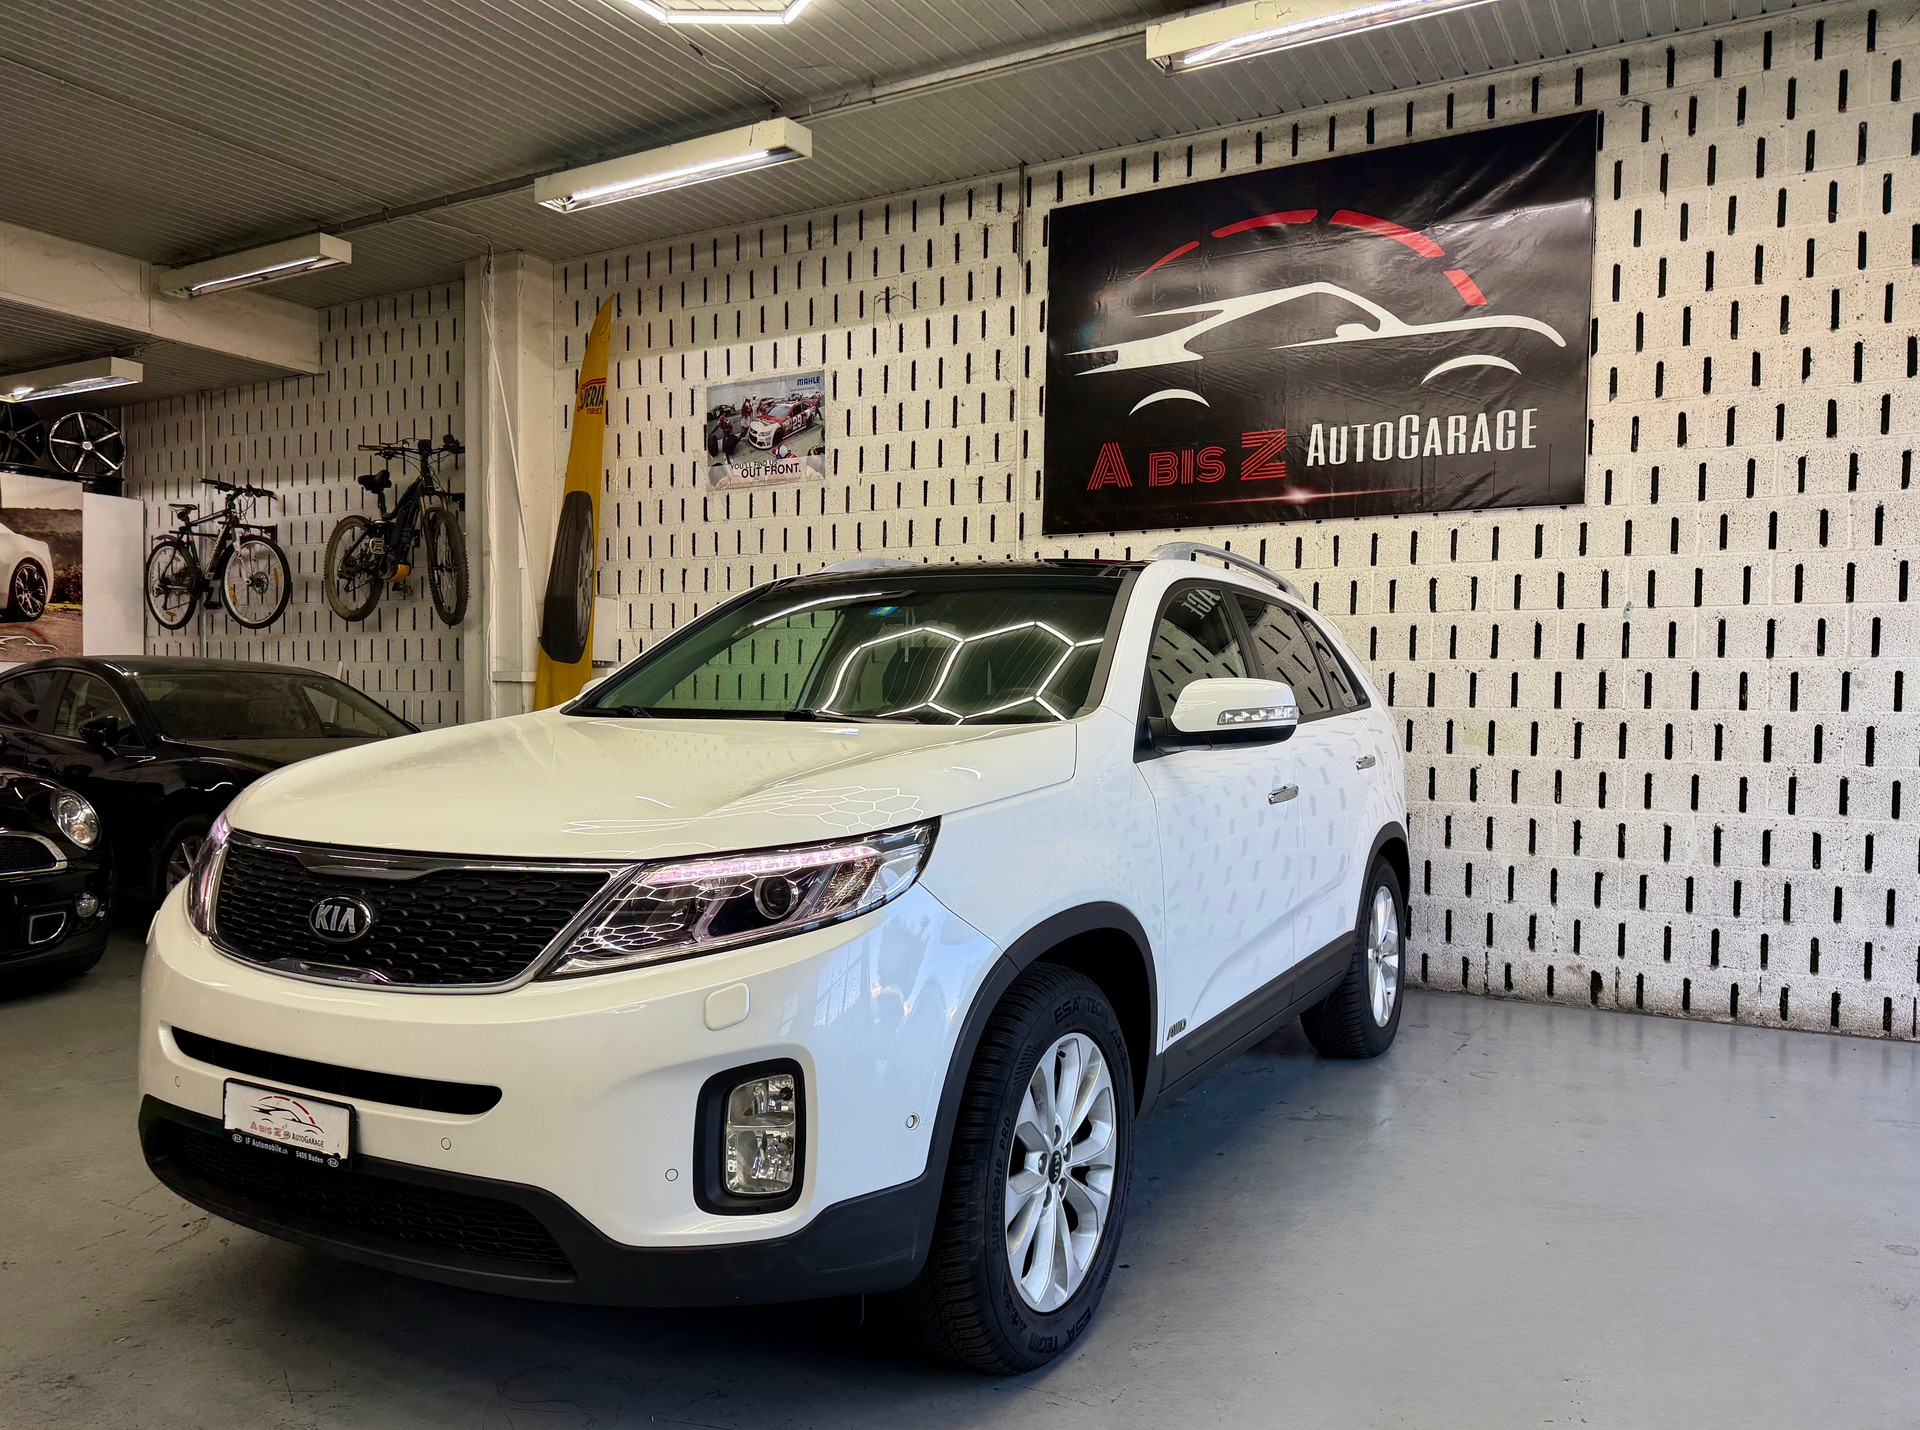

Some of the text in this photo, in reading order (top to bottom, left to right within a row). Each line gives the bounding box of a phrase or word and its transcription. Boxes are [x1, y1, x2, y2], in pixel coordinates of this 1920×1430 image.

[797, 376, 820, 386] MAHLE
[586, 407, 603, 415] TIRES
[1086, 407, 1538, 491] A BIS Z AUTOGARAGE
[731, 462, 753, 470] YOU'LL
[741, 463, 801, 478] OUT FRONT.
[315, 904, 356, 934] KIA
[250, 1121, 258, 1131] A
[258, 1125, 273, 1135] BIS
[292, 1132, 324, 1147] AUTOGARAGE
[992, 1116, 1011, 1255] SUPERGRIP PRO
